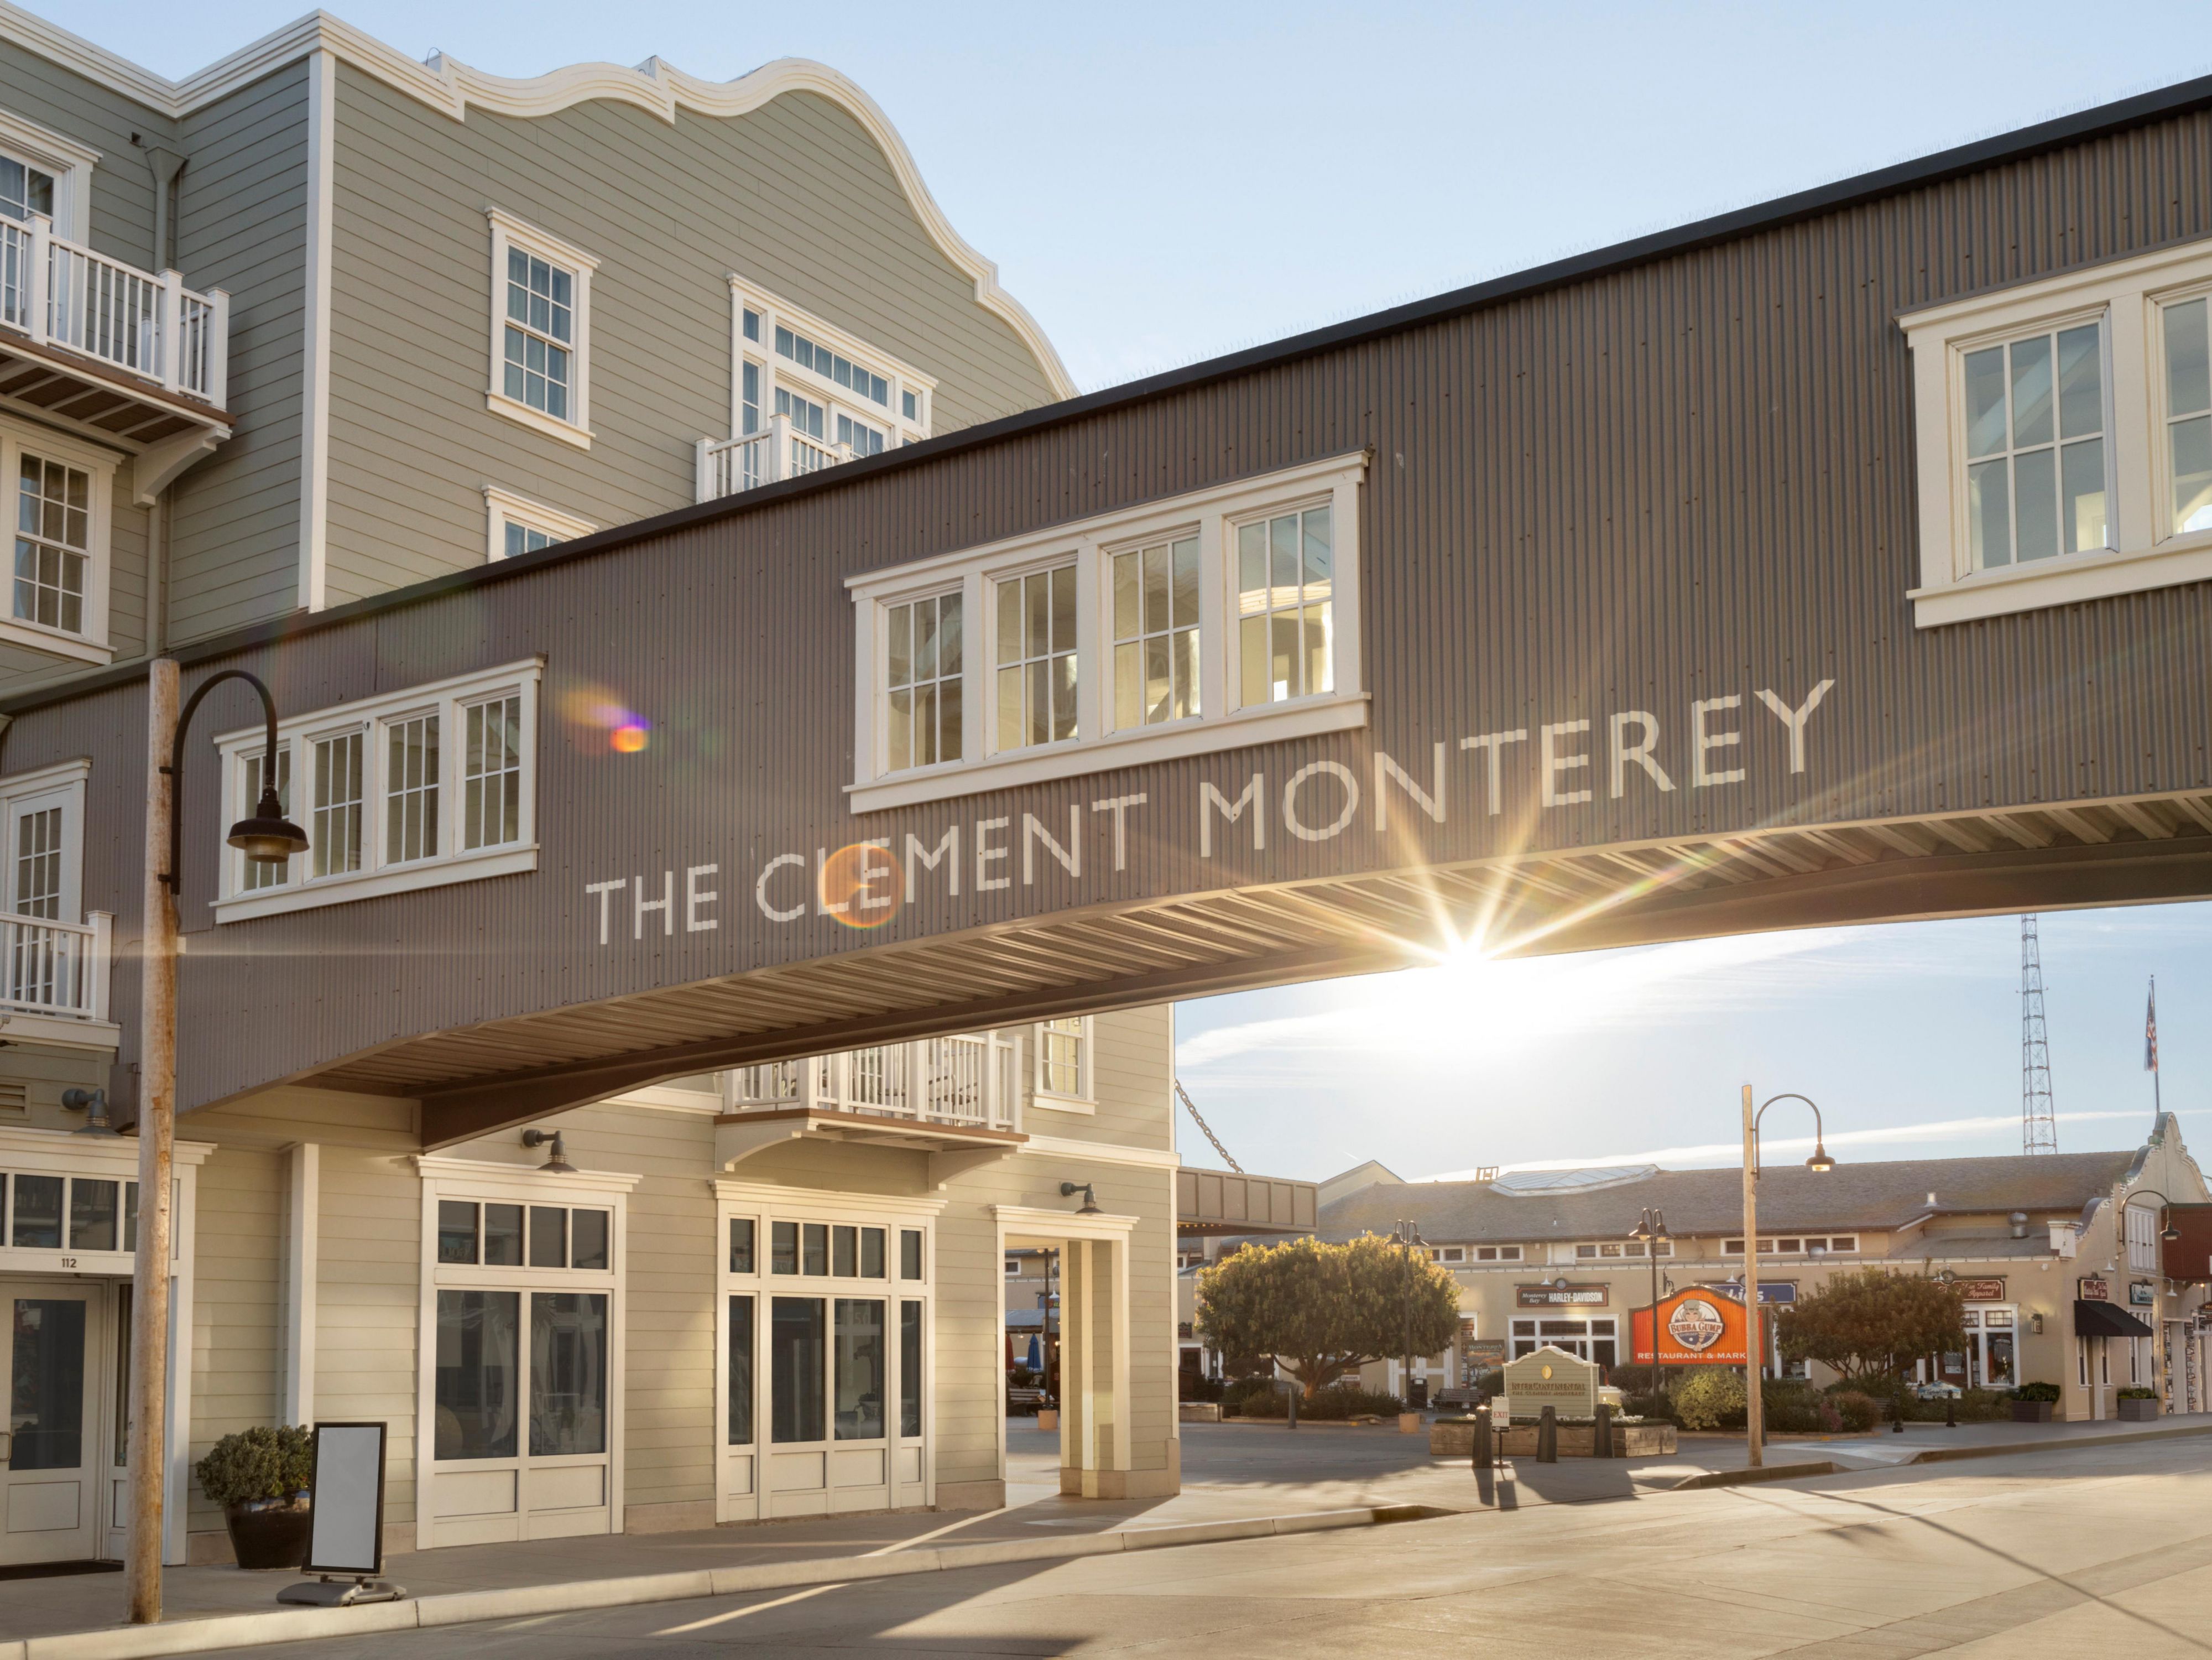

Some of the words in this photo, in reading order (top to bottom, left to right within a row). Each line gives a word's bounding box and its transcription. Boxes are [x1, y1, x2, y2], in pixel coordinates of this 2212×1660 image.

[586, 863, 718, 945] THE
[756, 793, 1147, 922] CLEMENT
[1200, 679, 1836, 858] MONTEREY
[61, 1258, 77, 1268] 112
[1977, 1282, 2000, 1291] Family
[1549, 1292, 1603, 1302] HARLEY-DAVIDSON
[1729, 1289, 1764, 1302] Lis
[1968, 1289, 1994, 1298] Apparel
[1671, 1323, 1697, 1333] BUBBA
[1698, 1321, 1721, 1333] GUMP
